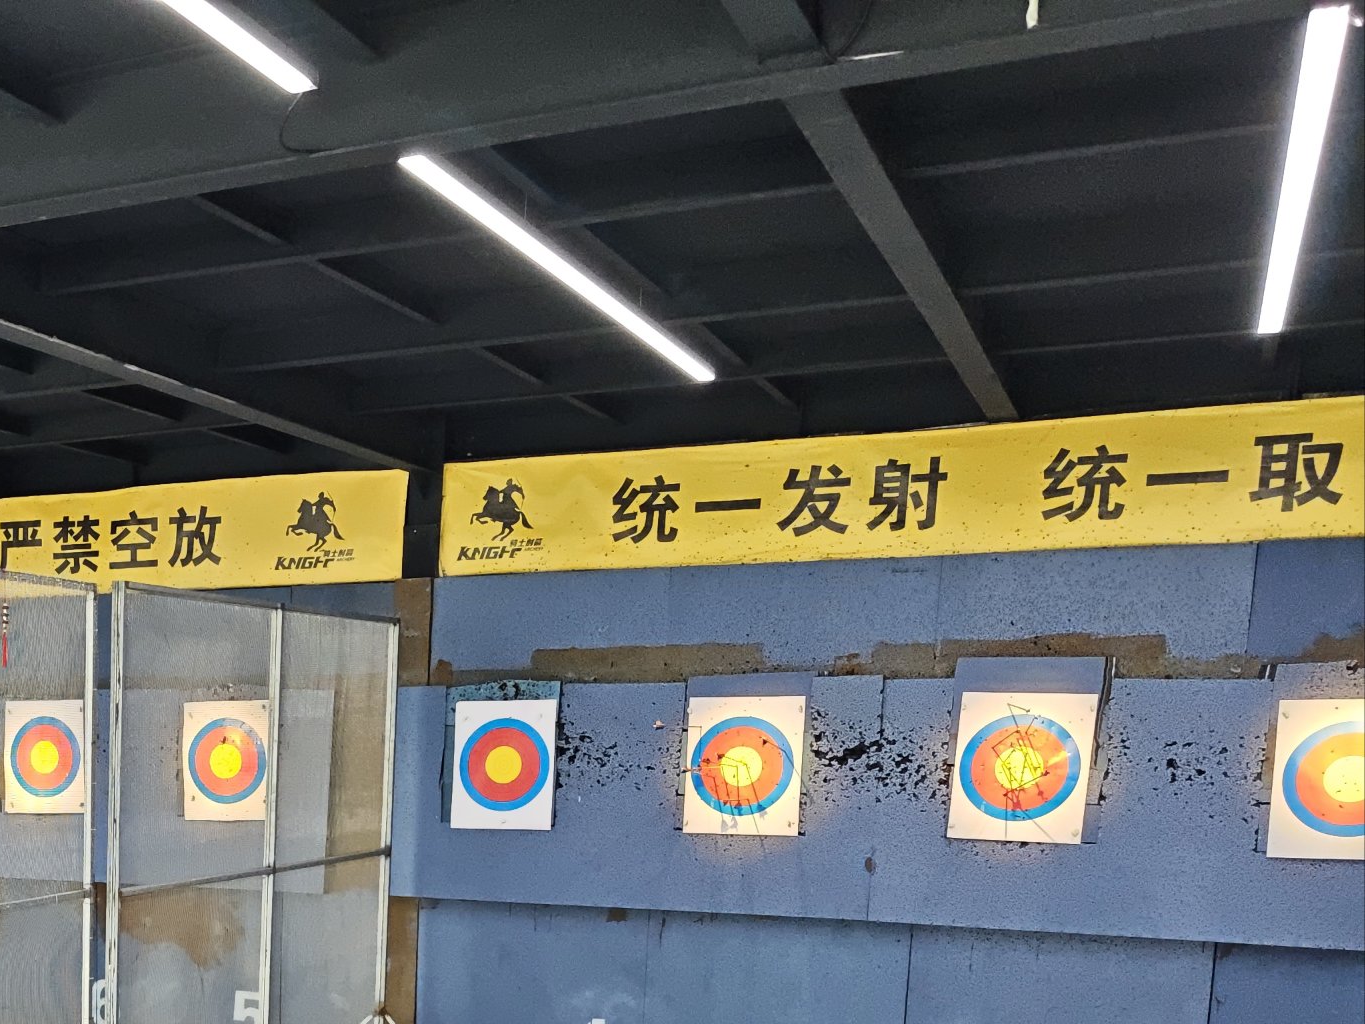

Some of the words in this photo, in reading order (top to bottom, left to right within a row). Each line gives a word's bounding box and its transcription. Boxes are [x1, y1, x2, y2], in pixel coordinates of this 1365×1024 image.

[611, 456, 949, 544] 统一发射
[1040, 431, 1345, 523] 统一取
[0, 505, 222, 576] 严禁空放
